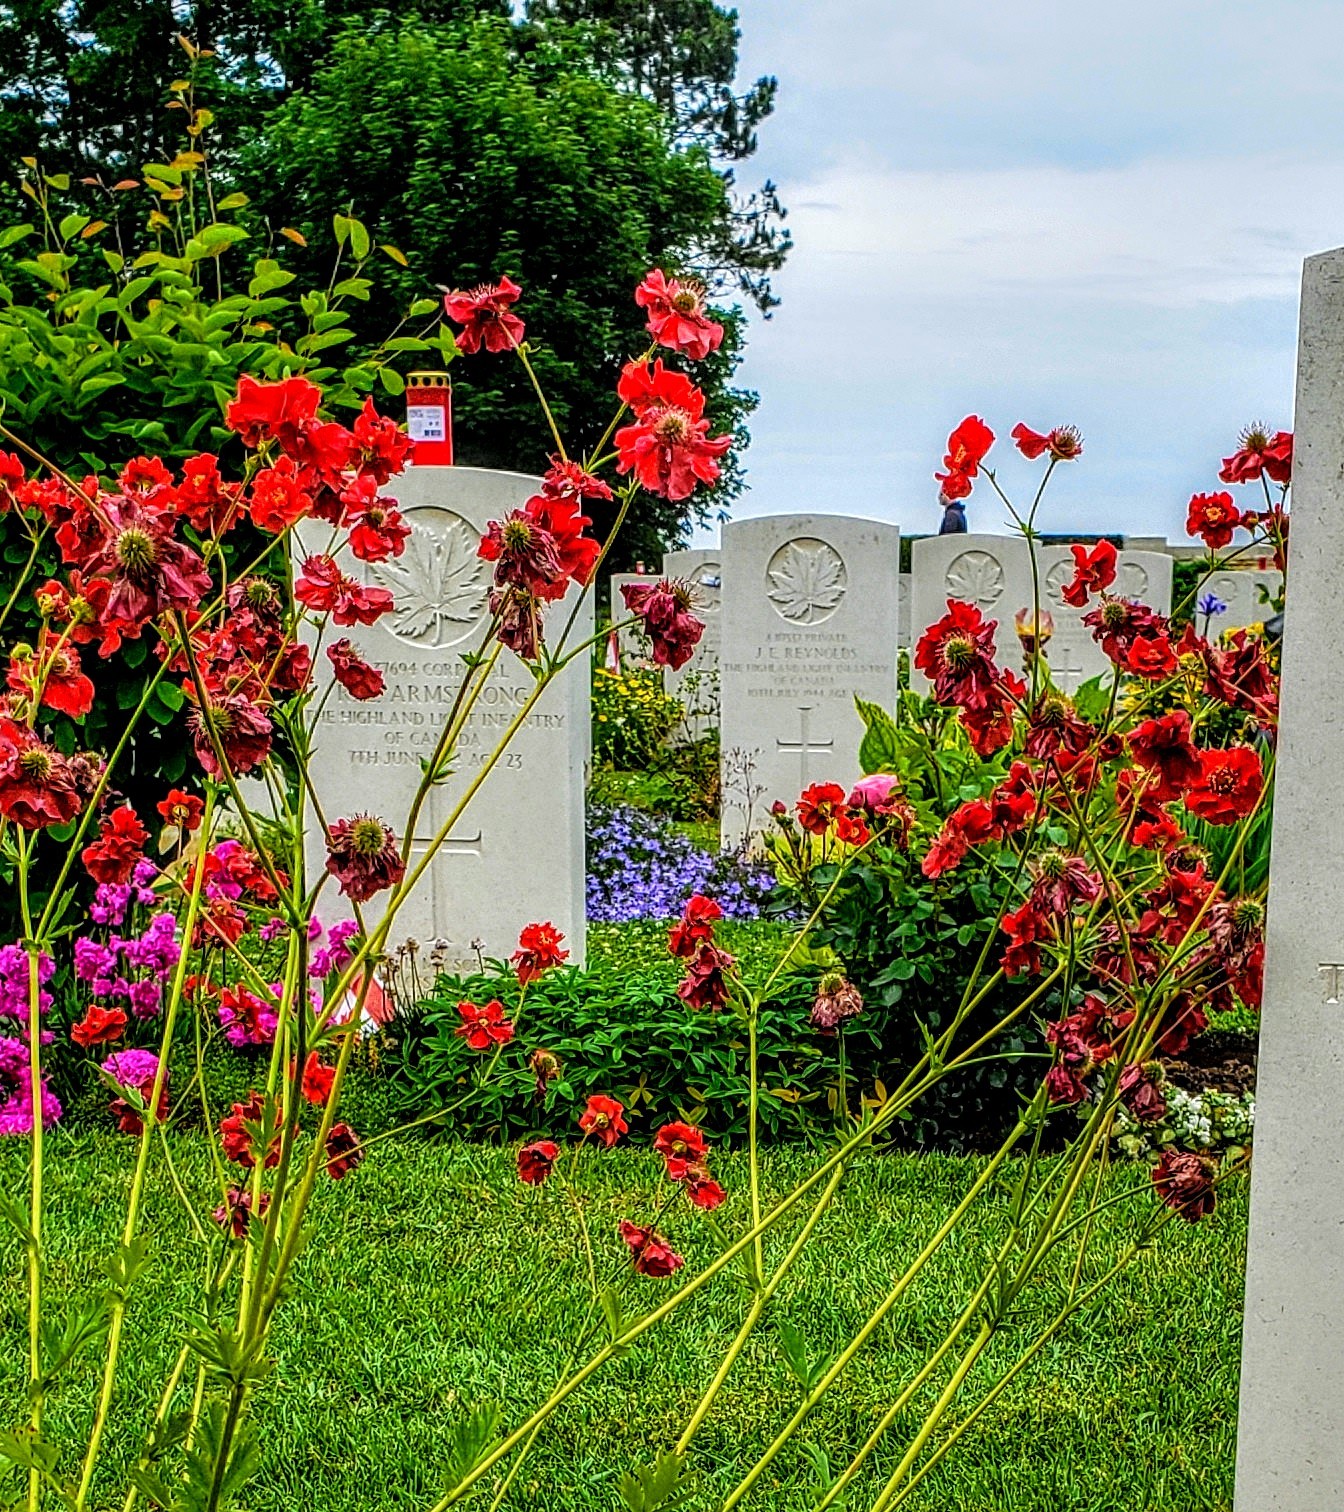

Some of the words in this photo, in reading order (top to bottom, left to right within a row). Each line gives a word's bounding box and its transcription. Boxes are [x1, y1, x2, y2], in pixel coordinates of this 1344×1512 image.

[422, 662, 510, 678] CORPAL
[390, 685, 529, 706] ARMSONG
[340, 710, 425, 727] HIGHLAND
[383, 731, 404, 747] OF
[409, 732, 482, 749] CANDA
[505, 753, 524, 771] 23
